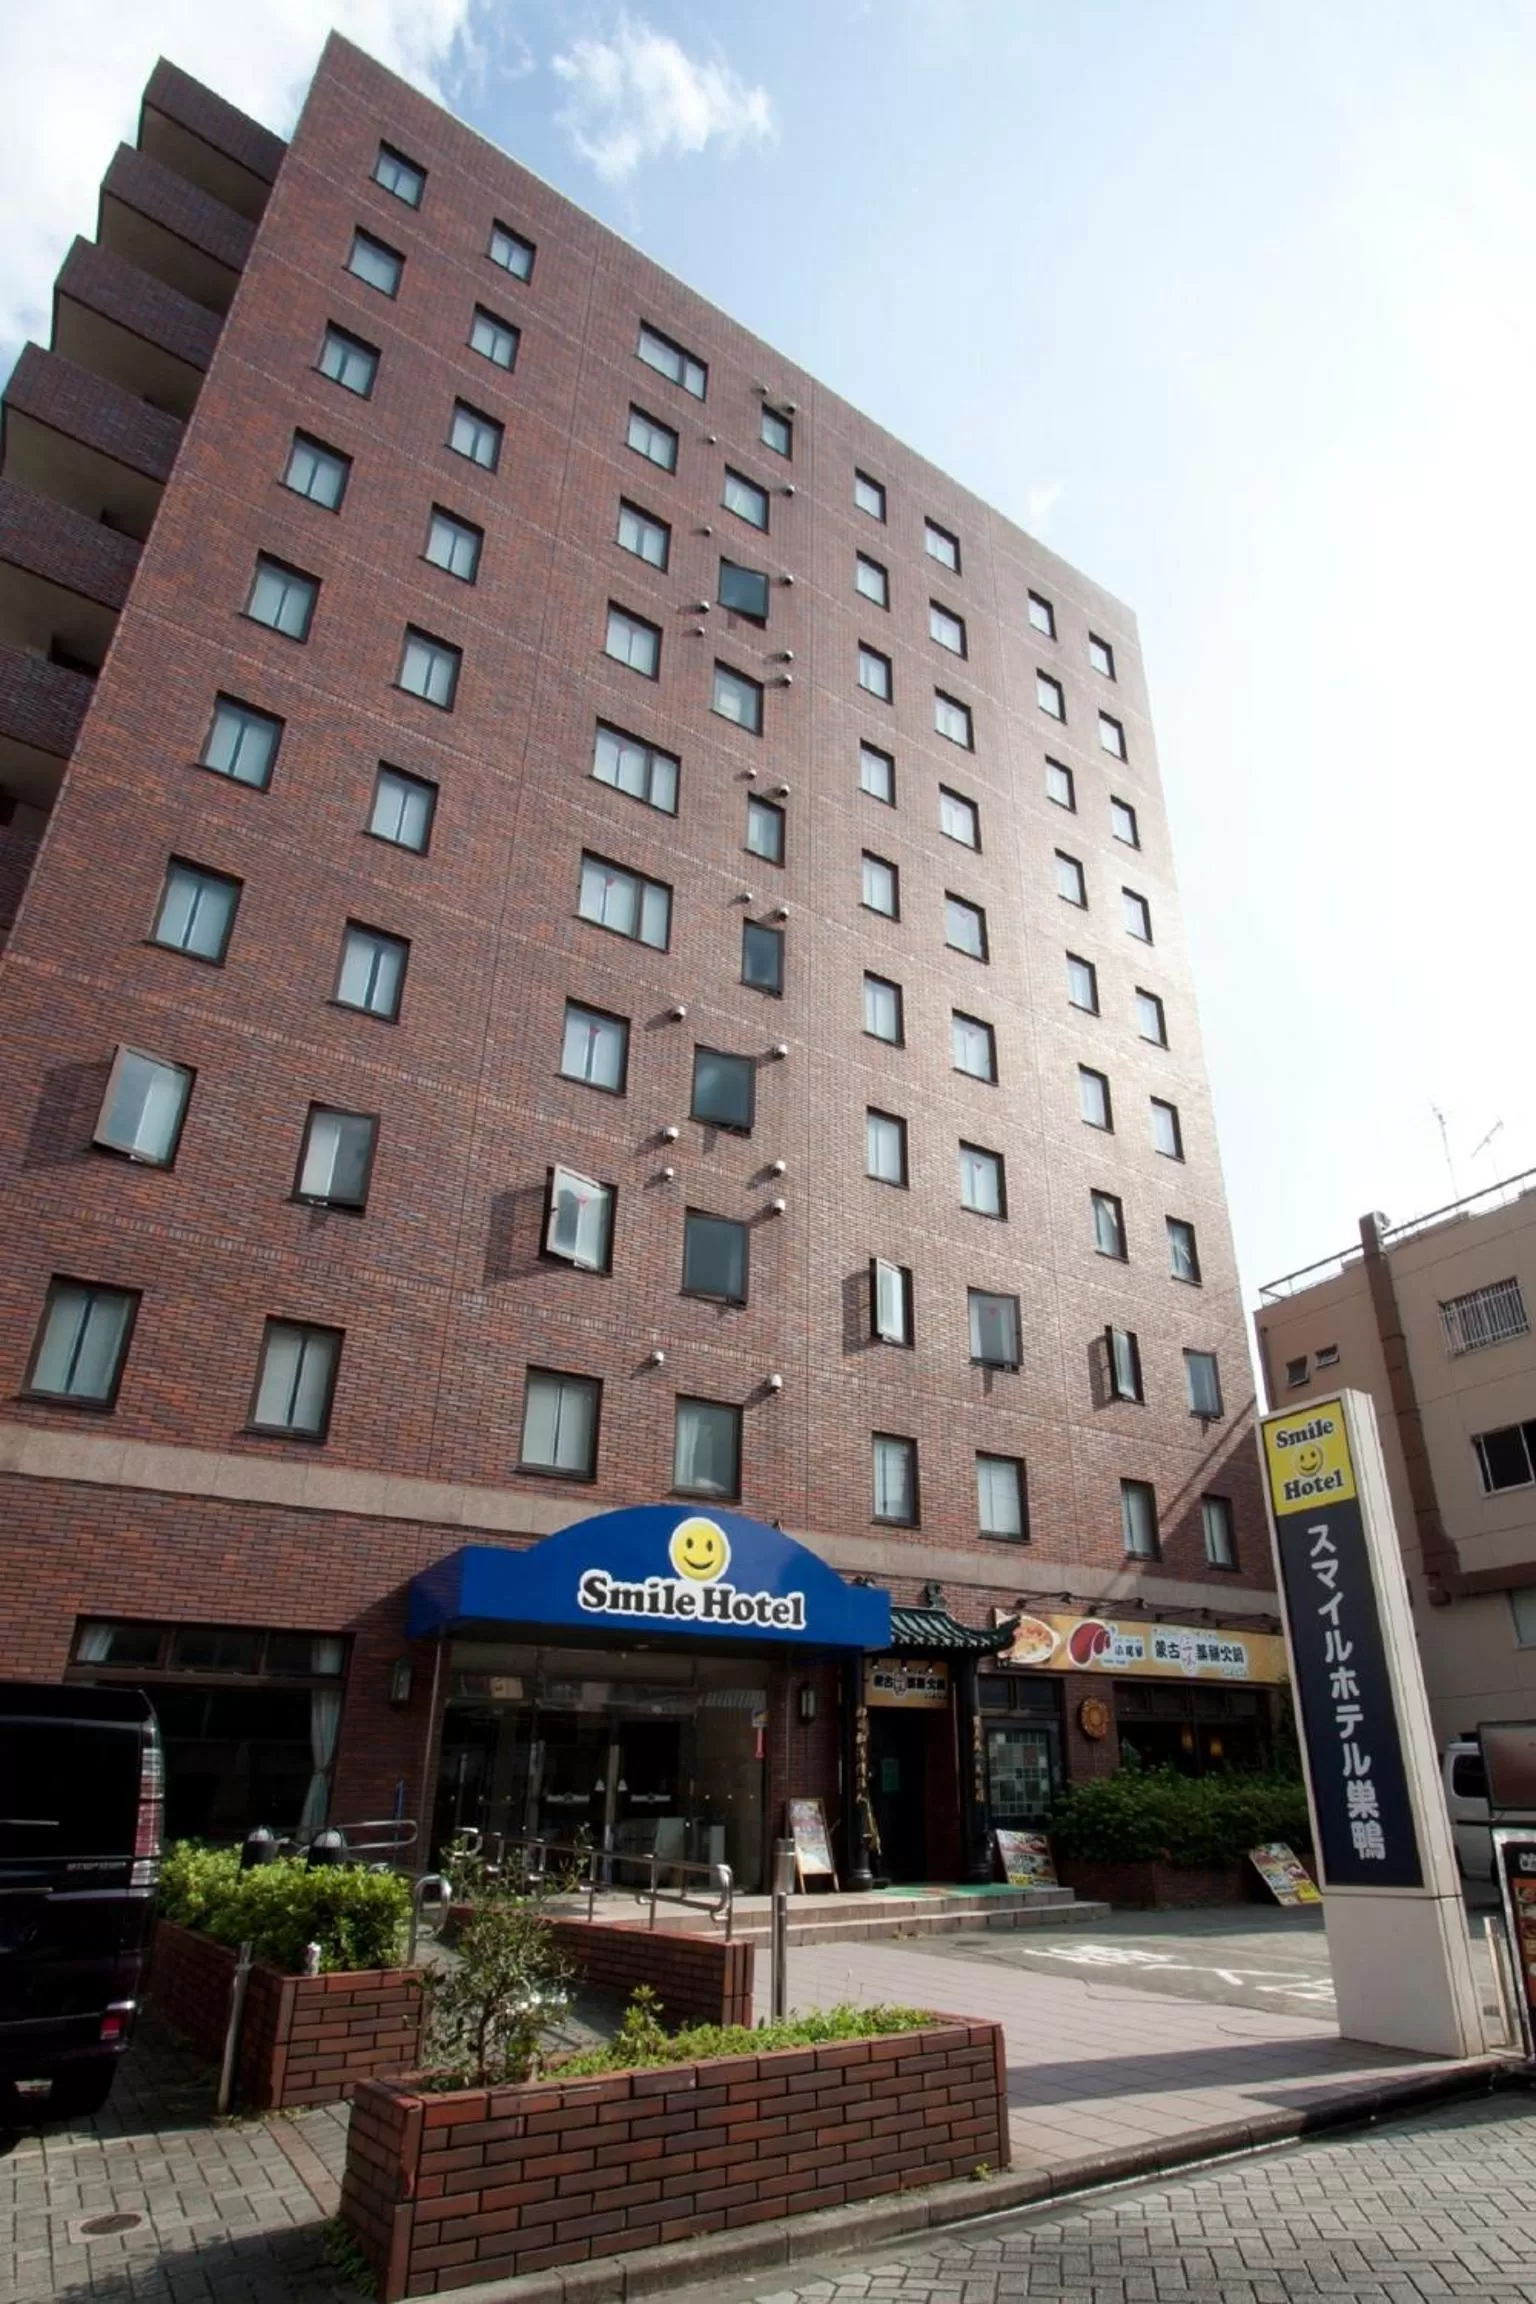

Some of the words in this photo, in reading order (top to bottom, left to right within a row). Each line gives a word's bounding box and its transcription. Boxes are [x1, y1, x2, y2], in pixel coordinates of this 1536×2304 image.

[1276, 1418, 1334, 1448] Smile
[1284, 1469, 1344, 1500] Hotel
[581, 1575, 696, 1617] Smile
[701, 1586, 803, 1626] Hotel
[1307, 1524, 1386, 1861] スマイルホテル巣鴨
